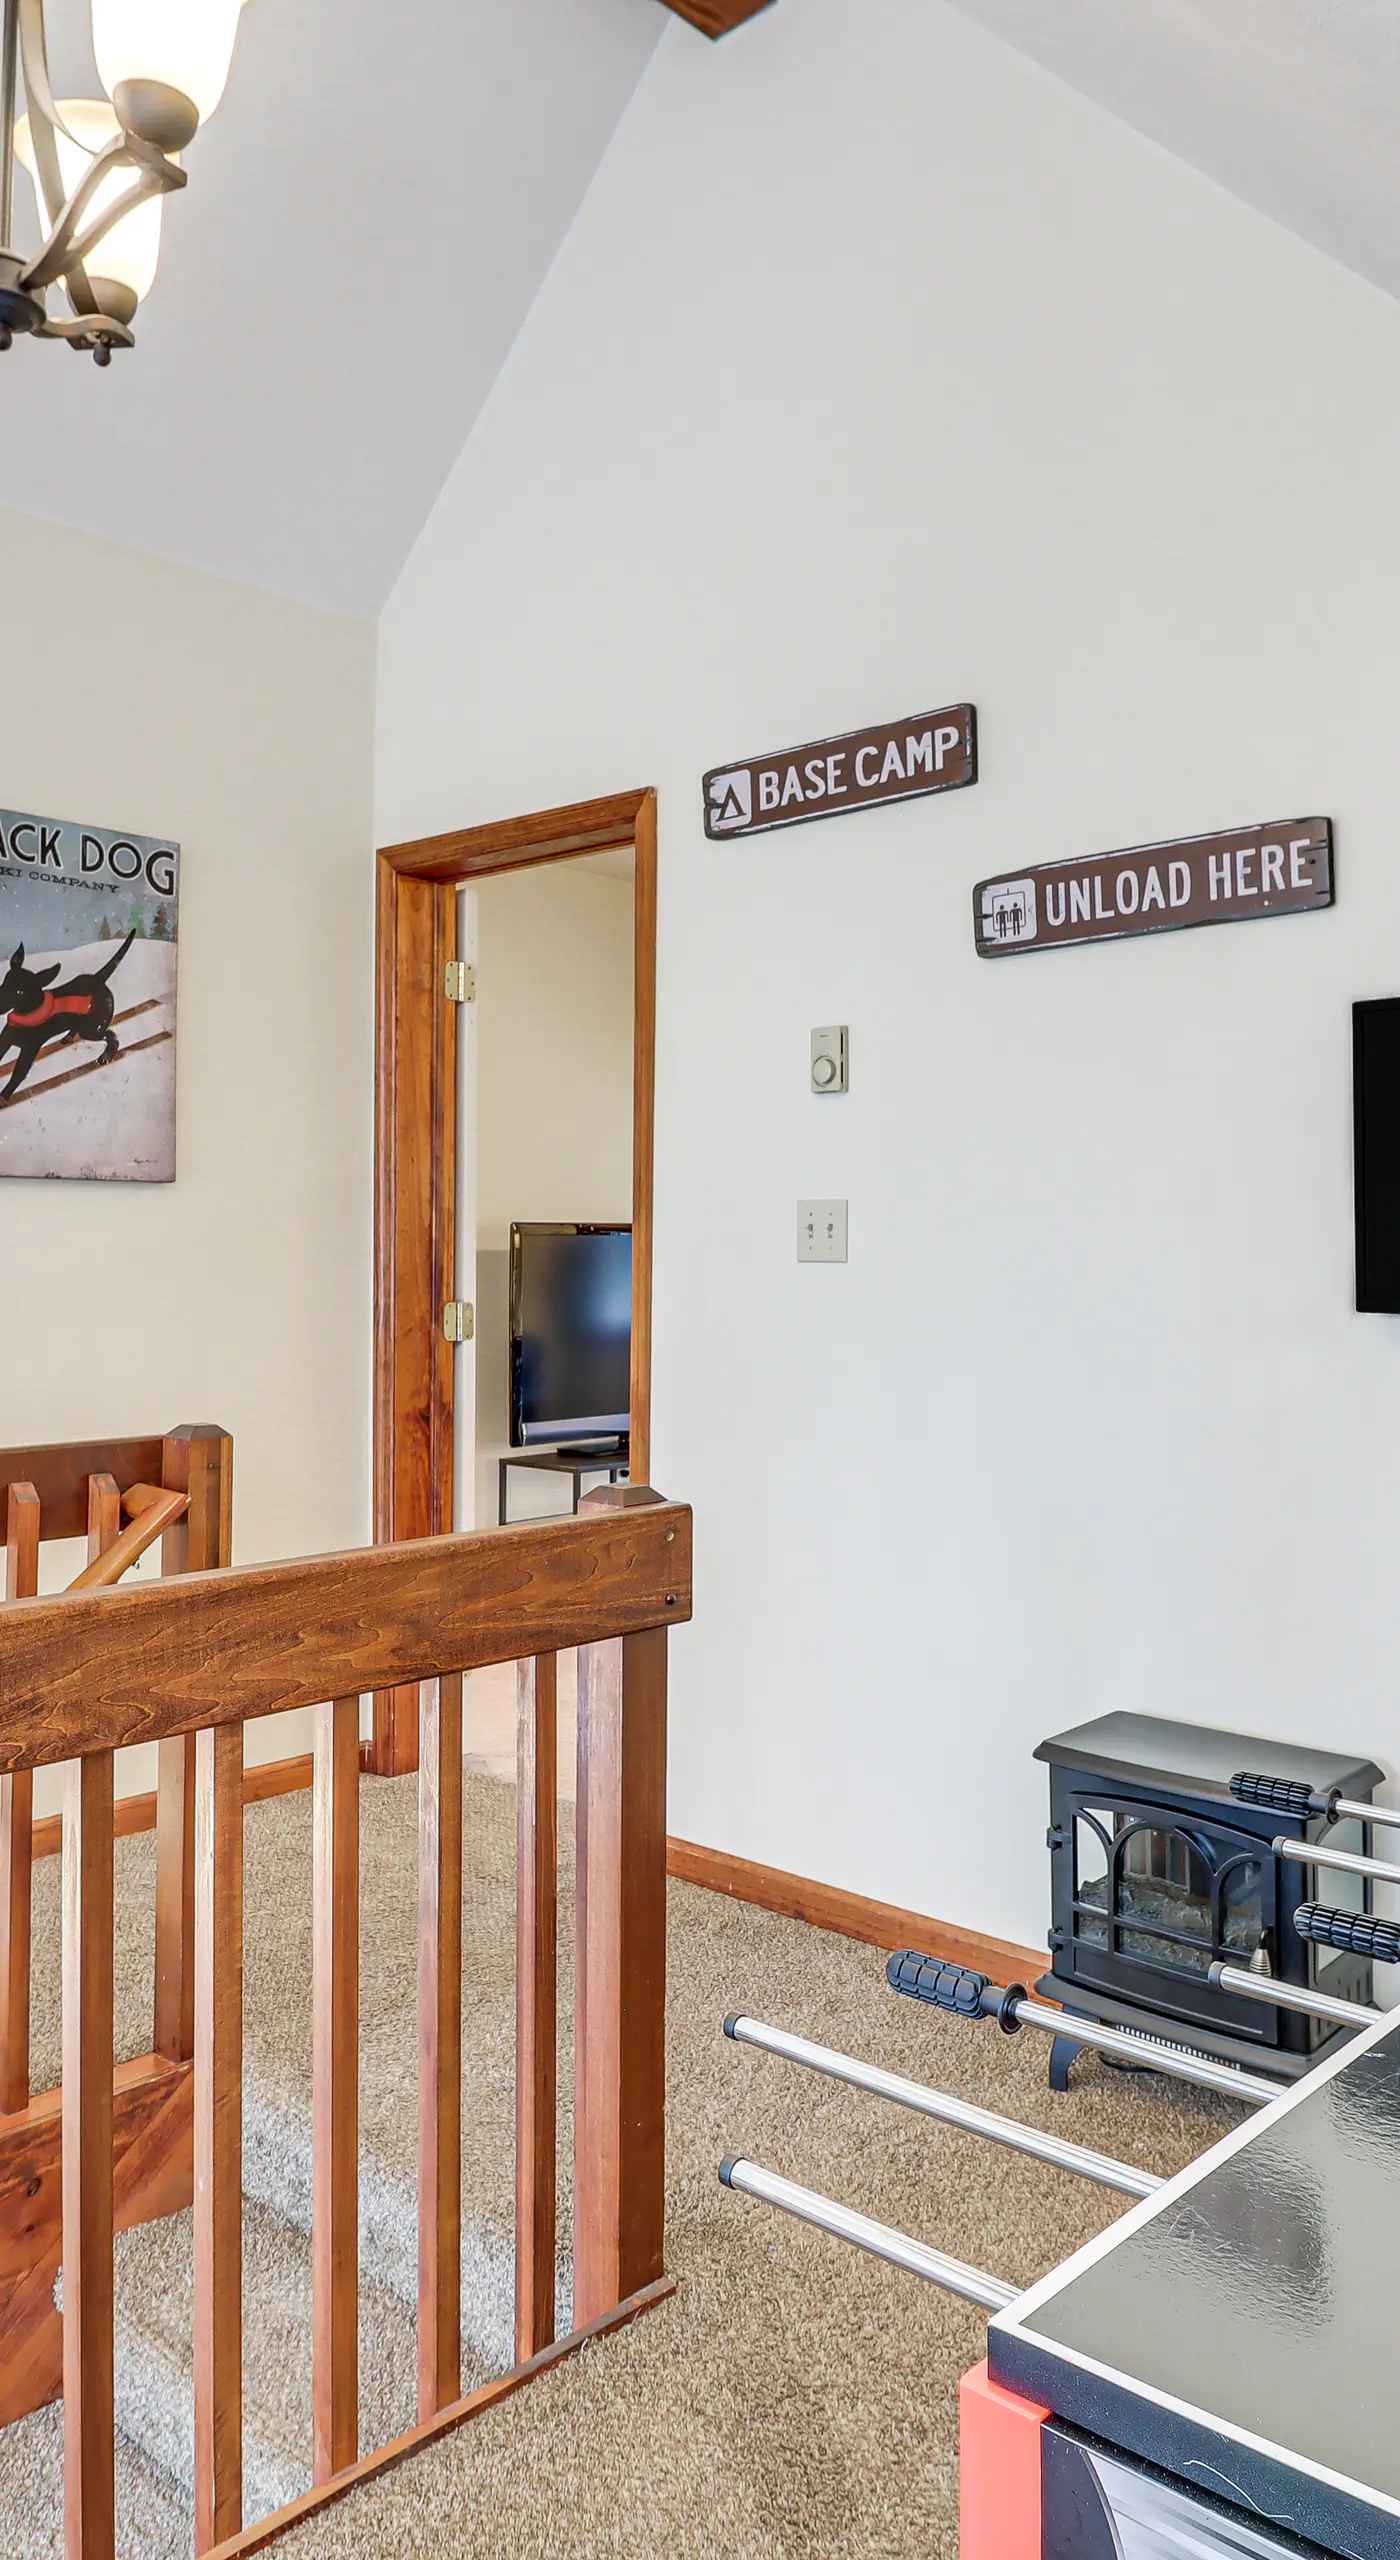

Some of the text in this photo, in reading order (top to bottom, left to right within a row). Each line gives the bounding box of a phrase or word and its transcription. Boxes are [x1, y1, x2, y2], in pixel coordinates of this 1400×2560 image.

[758, 726, 960, 811] BASE CAMP
[28, 870, 120, 894] COMPANY
[81, 833, 176, 896] DOG
[1045, 838, 1313, 926] UNLOAD HERE
